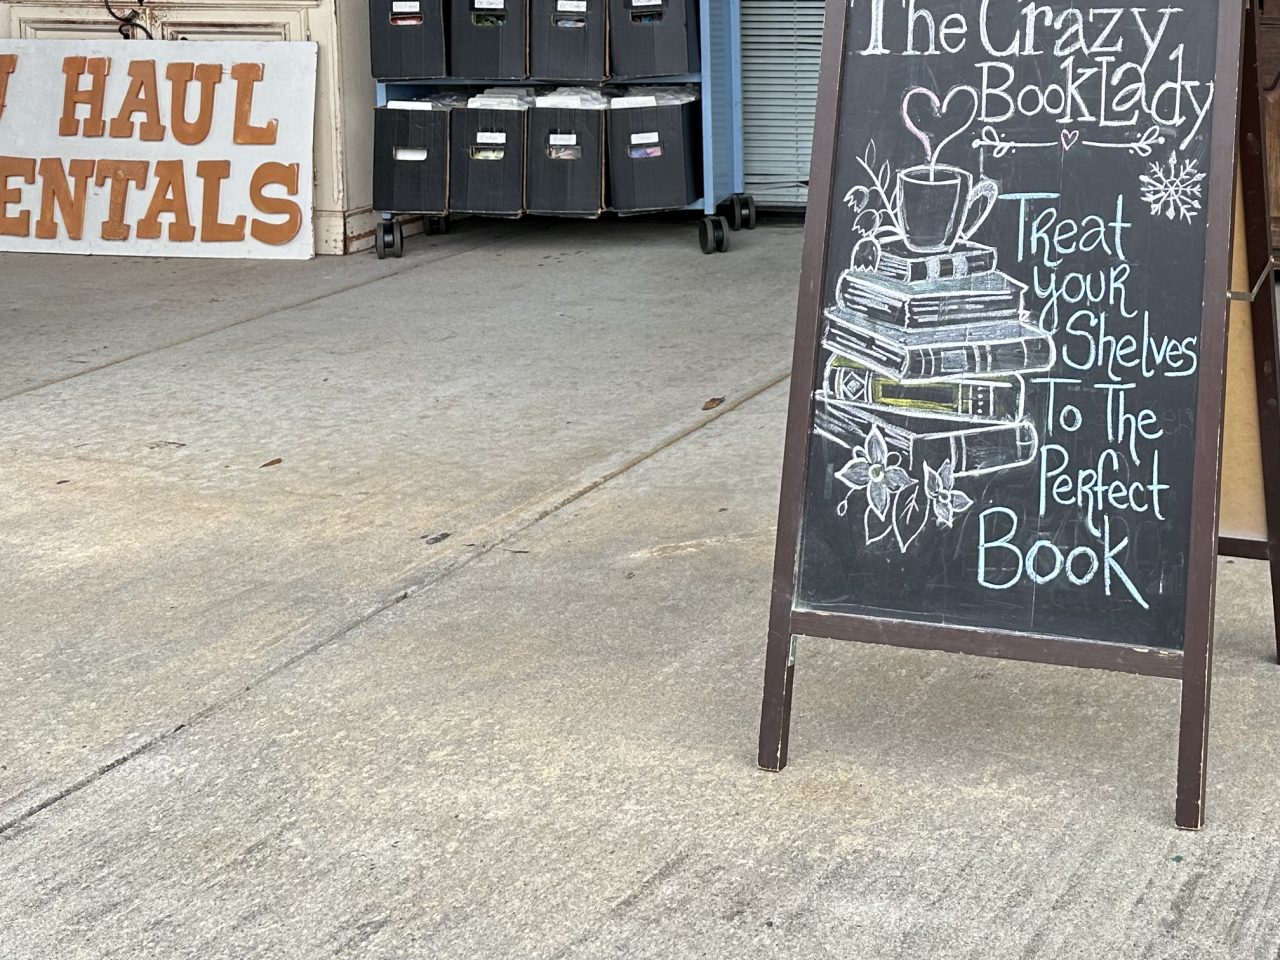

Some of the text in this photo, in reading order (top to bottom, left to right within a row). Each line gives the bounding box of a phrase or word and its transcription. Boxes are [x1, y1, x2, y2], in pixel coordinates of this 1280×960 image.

[59, 56, 279, 145] HAUL
[1062, 311, 1198, 380] Shelves
[1031, 377, 1163, 466] To The
[977, 506, 1149, 610] Book
